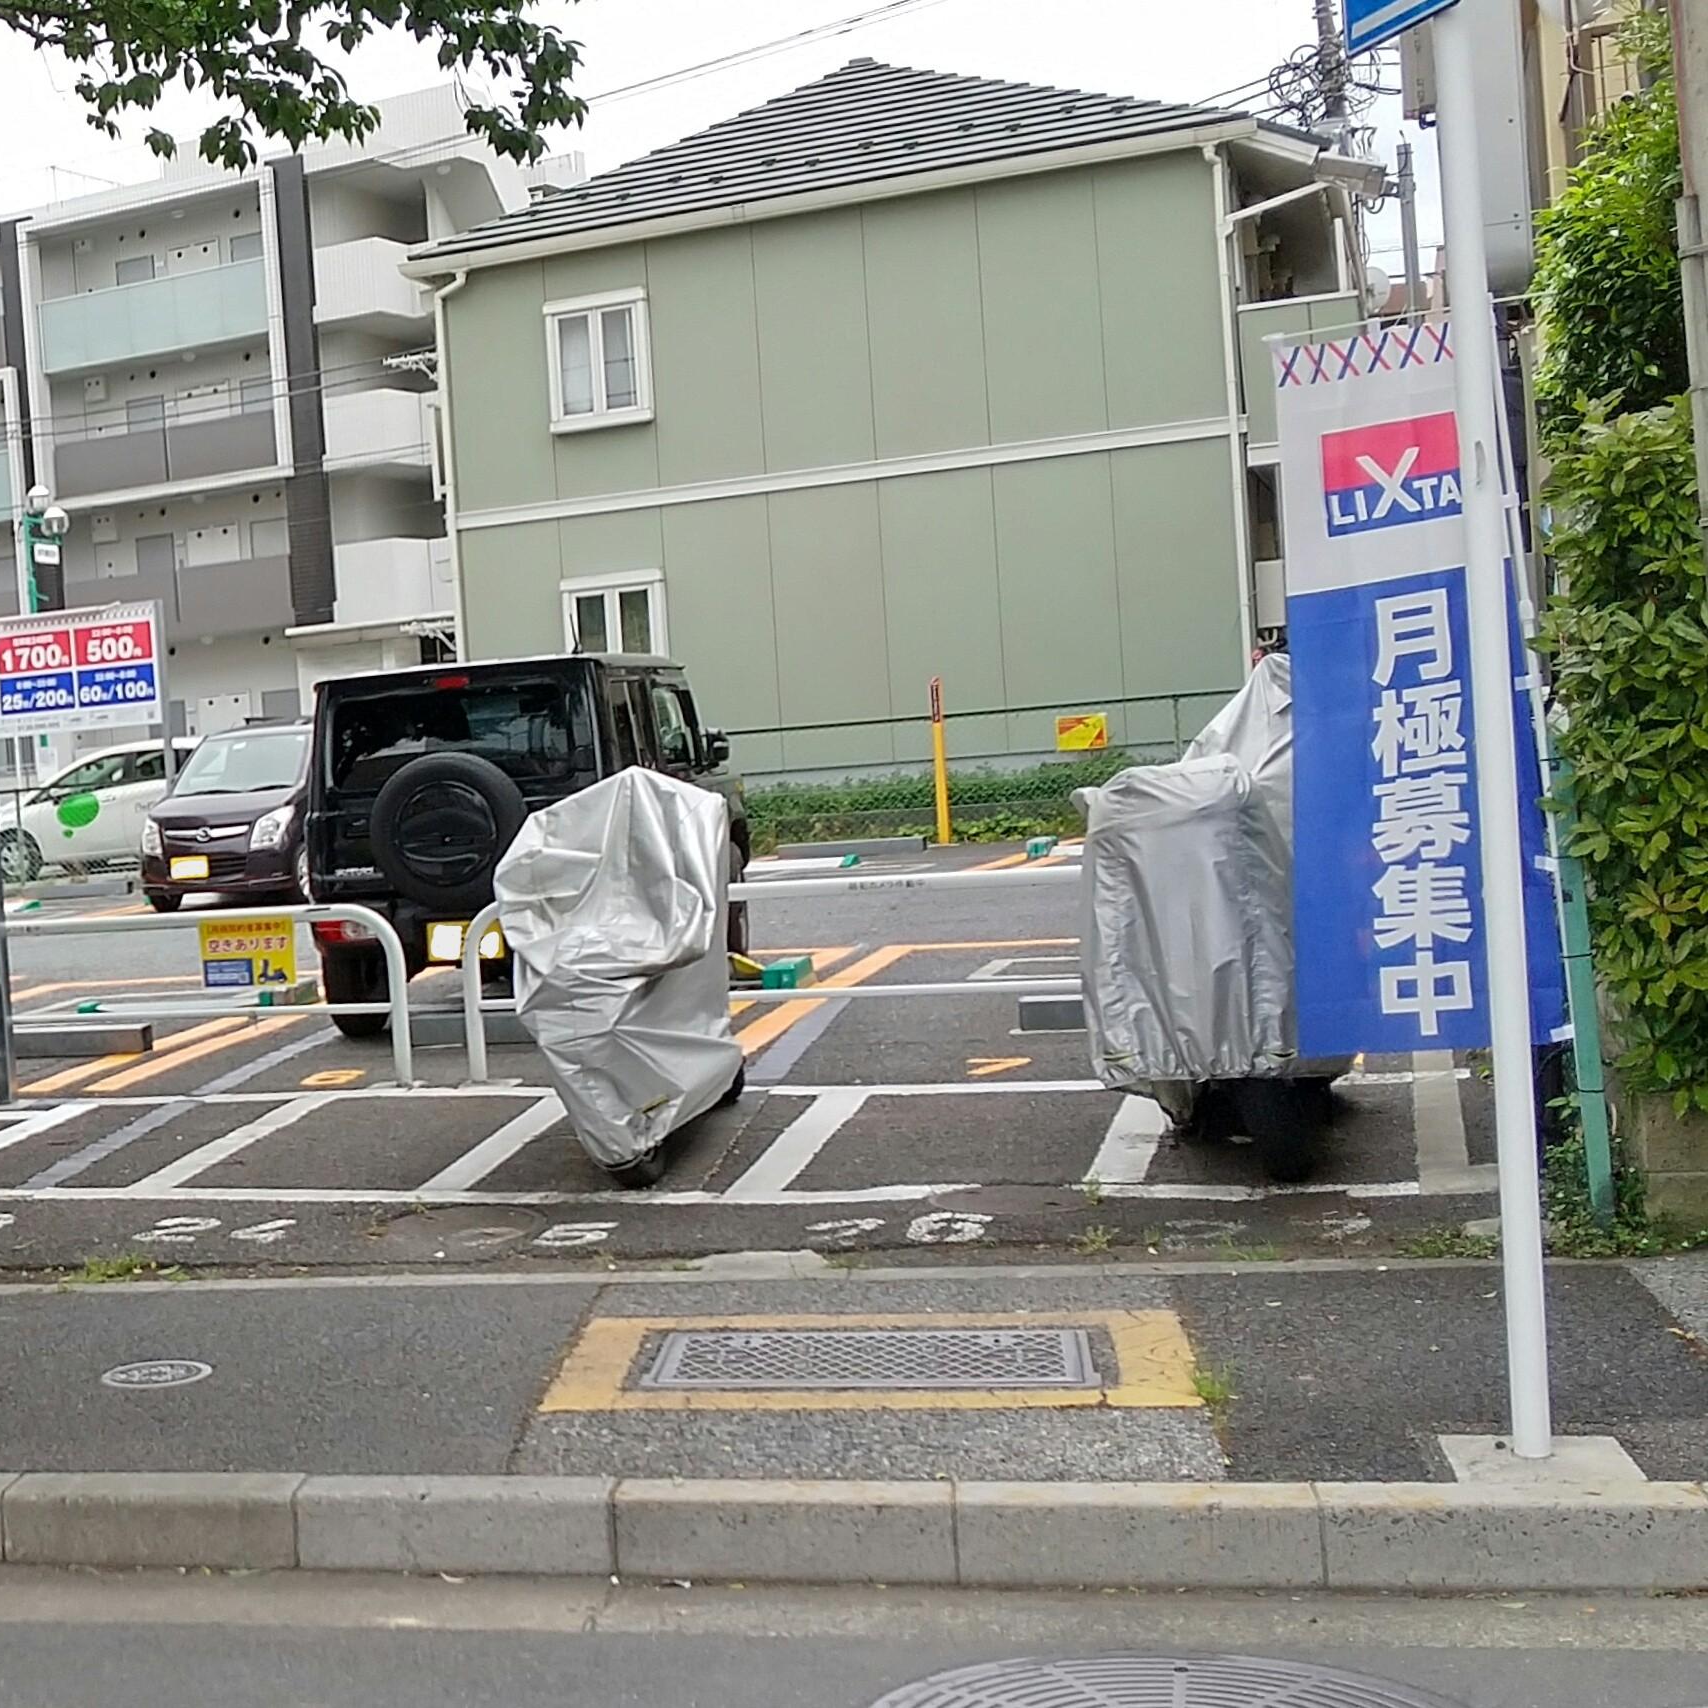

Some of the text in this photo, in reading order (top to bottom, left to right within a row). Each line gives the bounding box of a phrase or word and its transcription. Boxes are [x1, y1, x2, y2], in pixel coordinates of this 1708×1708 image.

[1333, 445, 1462, 525] LIXTA
[1371, 587, 1473, 1038] 月極募集中
[207, 936, 288, 953] 空きあります
